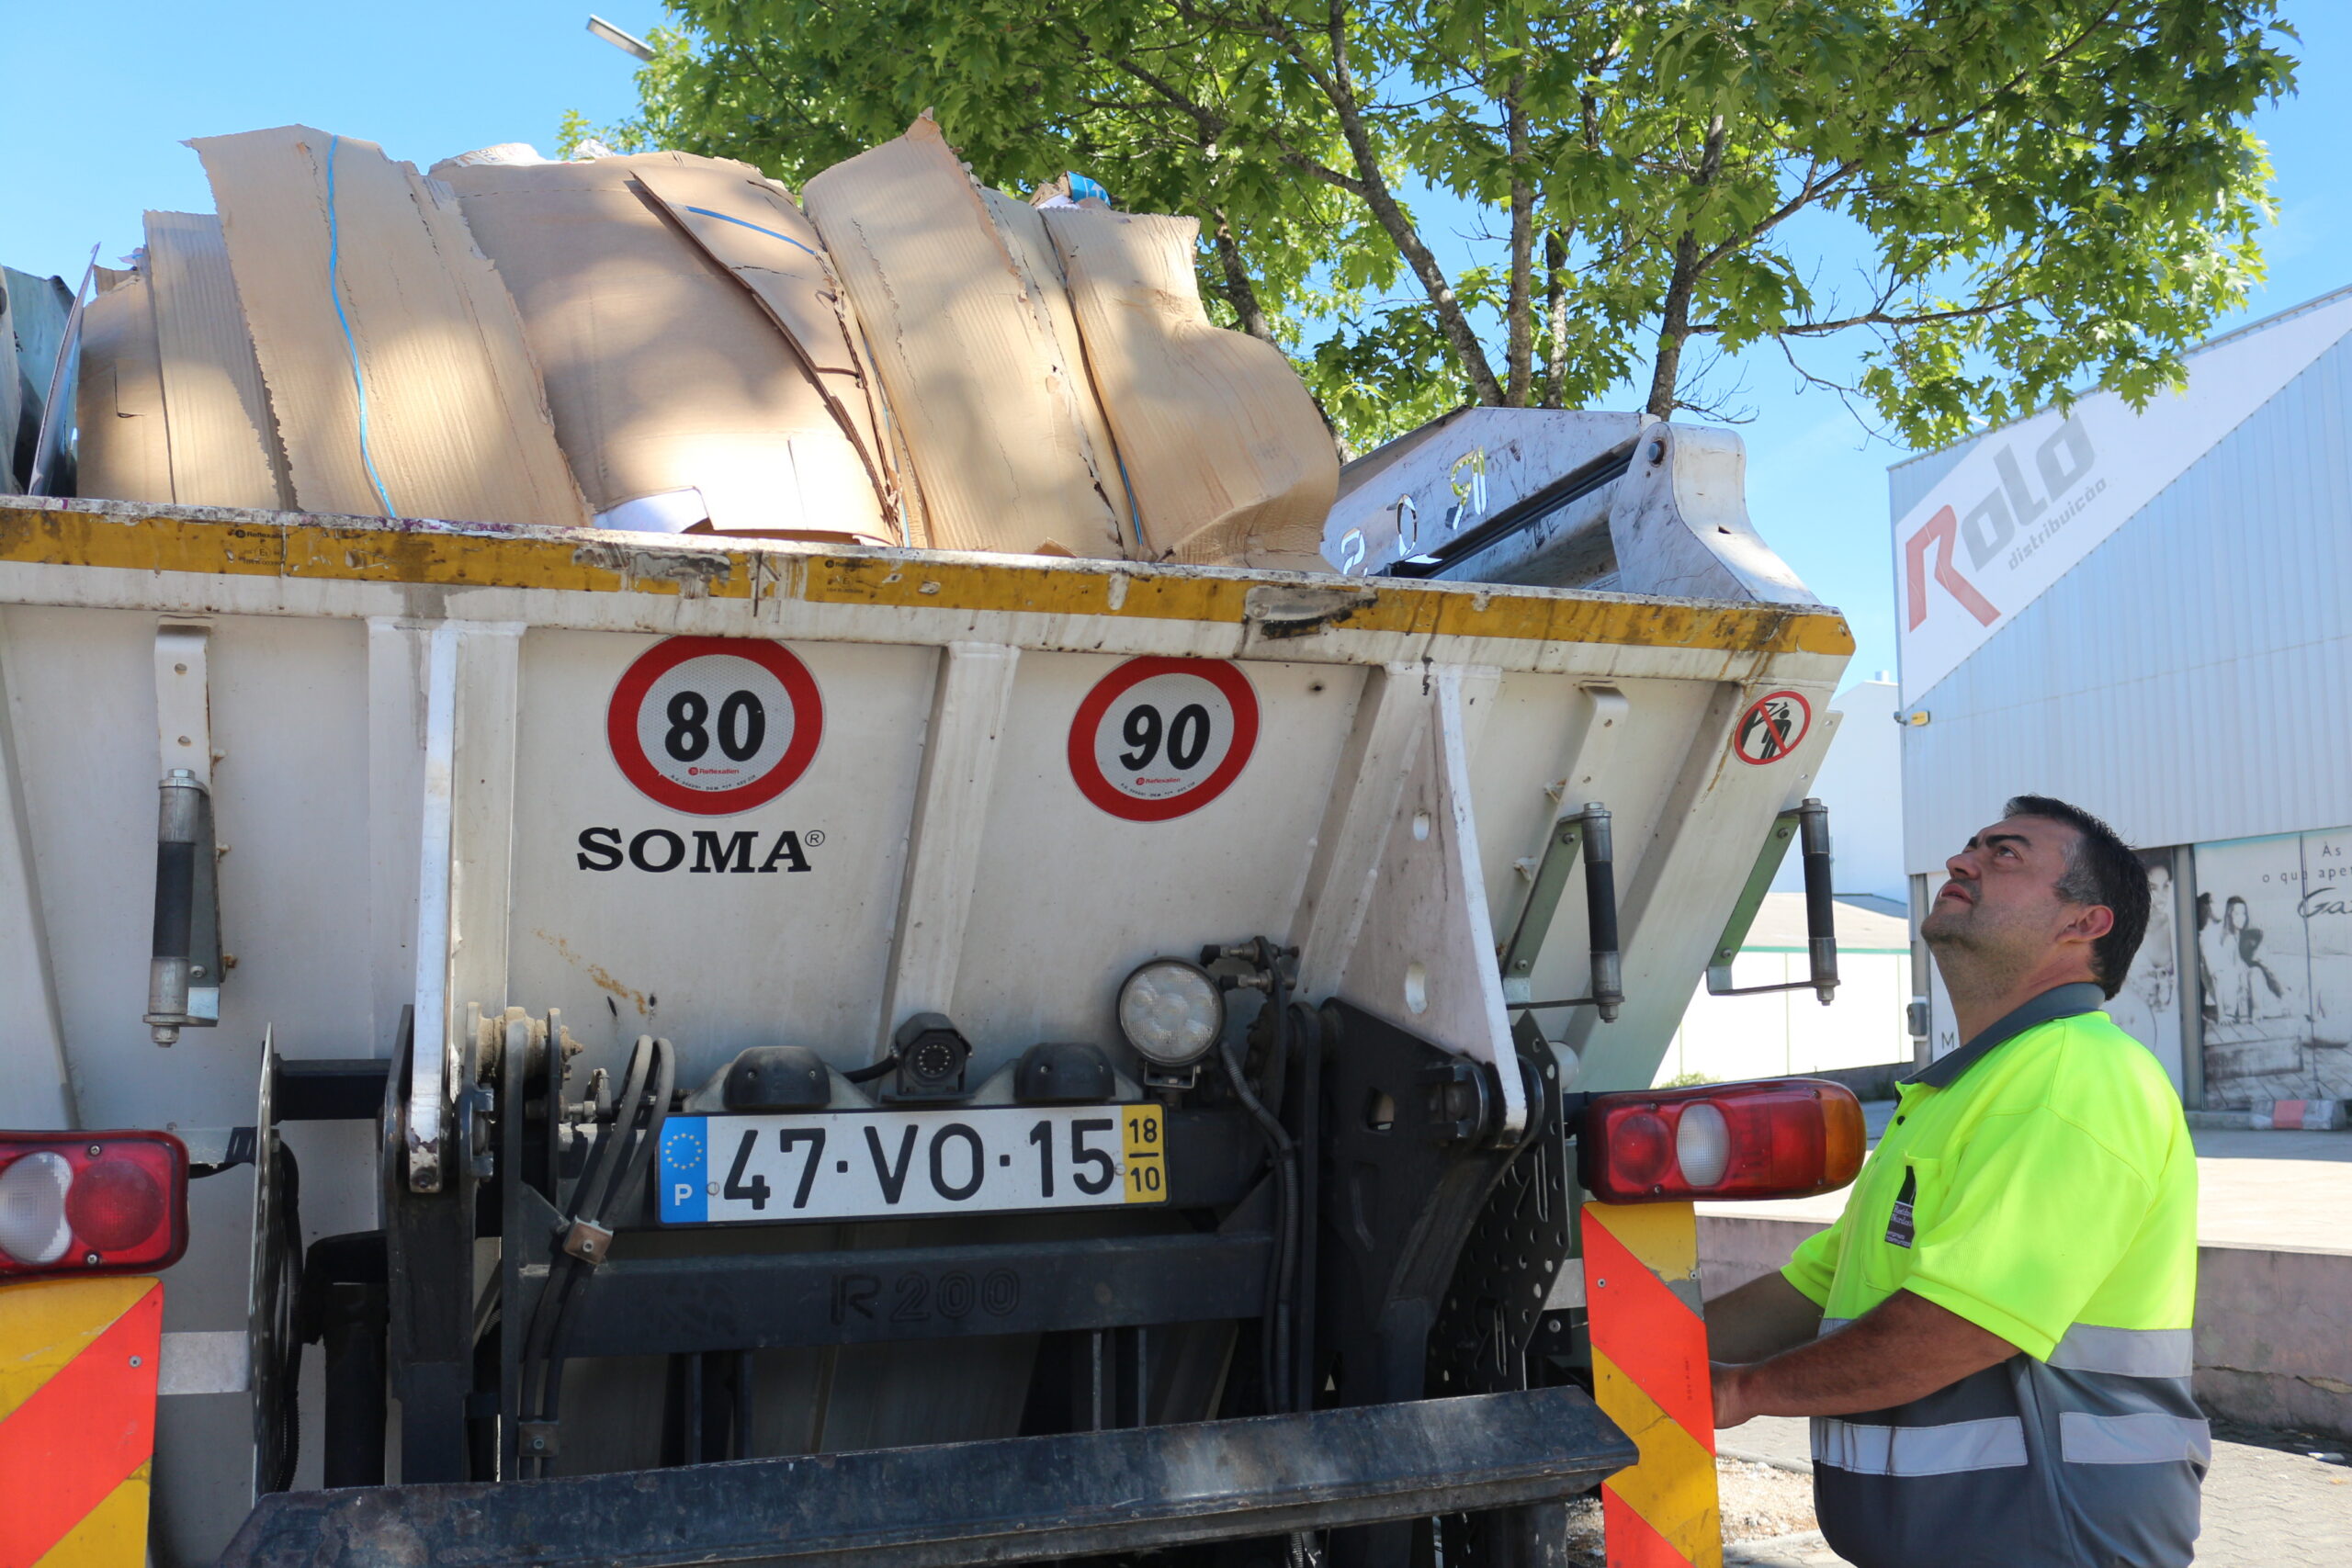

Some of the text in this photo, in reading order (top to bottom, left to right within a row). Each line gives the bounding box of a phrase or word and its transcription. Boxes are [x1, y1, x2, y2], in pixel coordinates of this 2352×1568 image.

[664, 689, 766, 762] 80
[1119, 703, 1211, 772] 90
[2262, 874, 2270, 883] o
[2297, 886, 2352, 919] Ga
[1128, 1118, 1159, 1145] 18
[1129, 1166, 1160, 1193] 10
[673, 1182, 693, 1208] P
